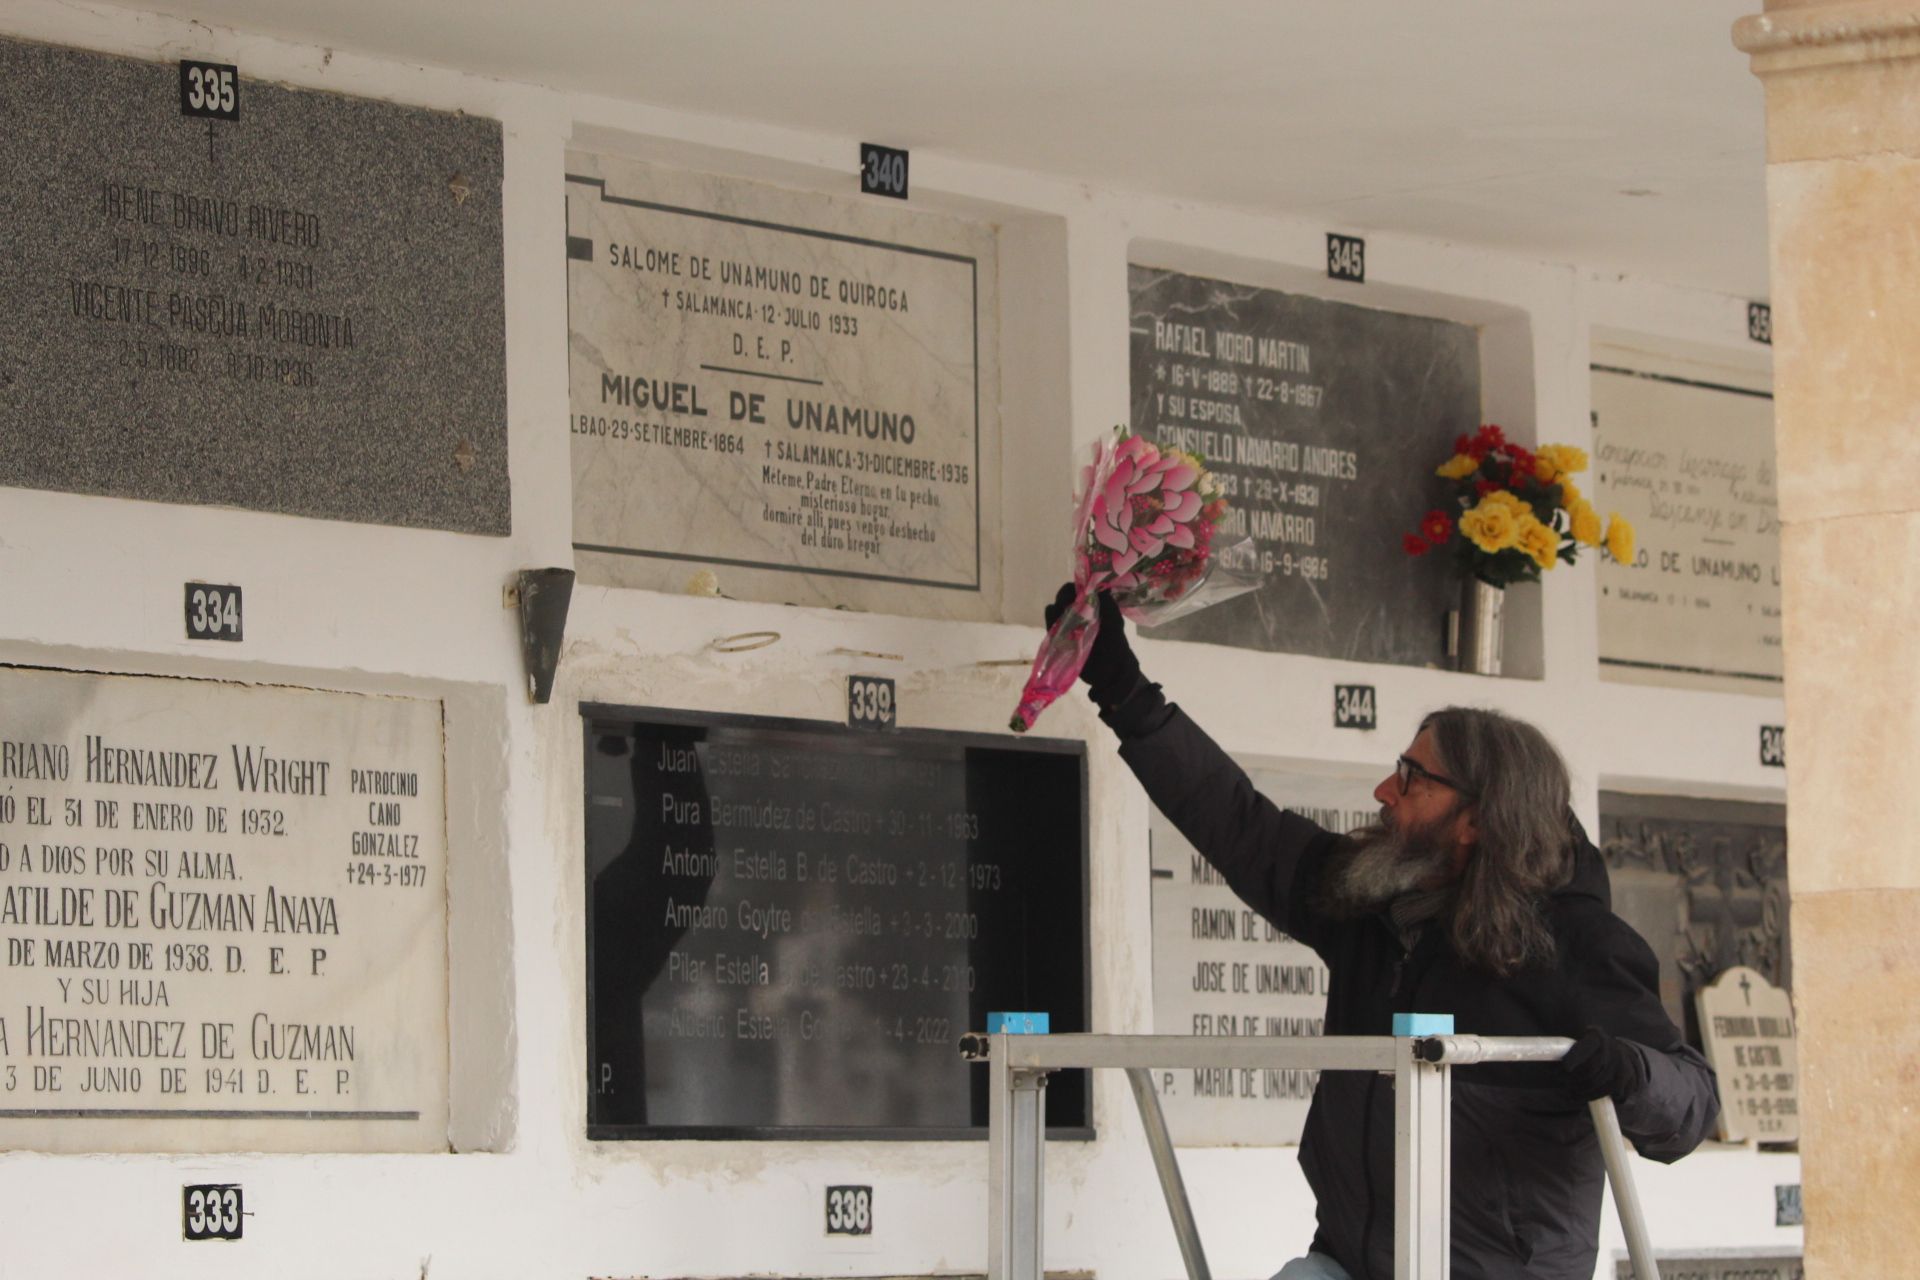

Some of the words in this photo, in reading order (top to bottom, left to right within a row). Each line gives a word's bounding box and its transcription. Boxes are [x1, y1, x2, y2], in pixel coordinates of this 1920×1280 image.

[188, 66, 235, 113] 335
[867, 151, 905, 193] 340
[101, 180, 162, 226] IRENE
[173, 192, 239, 237] BRAVO
[249, 204, 320, 249] RIVERO
[1329, 237, 1363, 278] 345
[609, 243, 681, 276] SALOME
[690, 255, 712, 281] DE
[720, 260, 801, 295] UNAMUNO
[810, 275, 831, 301] DE
[839, 280, 908, 313] QUIROGA
[69, 280, 158, 326] VICENTE
[169, 293, 248, 337] PASCUA
[259, 304, 353, 349] MORONTA
[829, 313, 858, 337] 1933
[1155, 321, 1211, 358] RAFAEL
[1258, 337, 1311, 374] MARTIN
[600, 373, 708, 416] MIGUEL
[729, 390, 766, 424] DE
[787, 398, 916, 445] UNAMUNO
[1157, 393, 1165, 415] Y
[1169, 395, 1185, 418] SU
[1189, 398, 1243, 426] ESPOSA
[1236, 434, 1299, 473] NAVARRO
[1303, 445, 1358, 480] ANDRES
[800, 490, 857, 515] misterioso
[801, 526, 817, 548] del
[828, 516, 852, 536] pues
[1251, 510, 1316, 546] NAVARRO
[1660, 550, 1681, 574] DE
[1691, 554, 1762, 584] UNAMUNO
[192, 590, 239, 634] 334
[852, 680, 892, 723] 339
[1337, 687, 1373, 725] 344
[1, 740, 70, 782] RIANO
[85, 734, 219, 790] HERNANDEZ
[231, 743, 330, 797] WRIGHT
[657, 741, 698, 773] Juan
[350, 769, 419, 798] PATROCINIO
[26, 795, 53, 826] EL
[64, 798, 83, 828] 31
[94, 799, 119, 829] DE
[132, 801, 194, 832] ENERO
[206, 806, 228, 834] DE
[368, 801, 402, 827] CANO
[662, 792, 701, 825] Pura
[710, 797, 792, 830] Bermúdez
[796, 801, 816, 831] de
[820, 801, 871, 836] Castro
[19, 843, 33, 873] A
[41, 844, 86, 875] DIOS
[95, 847, 134, 877] POR
[145, 849, 168, 878] SU
[177, 850, 243, 881] ALMA.
[351, 831, 419, 859] GONZALEZ
[662, 844, 722, 877] Antonio
[734, 848, 787, 881] Estella
[817, 853, 838, 883] de
[847, 853, 898, 886] Castro
[0, 885, 95, 927] ATILDE
[104, 889, 140, 929] DE
[150, 881, 256, 933] GUZMAN
[262, 885, 340, 936] ANAYA
[664, 896, 729, 936] Amparo
[738, 899, 792, 940] Goytre
[1191, 906, 1236, 940] RAMON
[1241, 909, 1259, 942] DE
[7, 937, 36, 967] DE
[44, 939, 120, 970] MARZO
[128, 942, 153, 970] DE
[668, 950, 707, 983] Pilar
[715, 953, 770, 985] Estella
[57, 977, 72, 1004] Y
[81, 978, 110, 1006] SU
[119, 979, 170, 1007] HIJA
[1192, 960, 1227, 993] JOSE
[1232, 962, 1250, 994] DE
[1256, 963, 1315, 996] UNAMUNO
[26, 1005, 187, 1059] HERNANDEZ
[200, 1022, 235, 1060] DE
[251, 1012, 355, 1062] GUZMAN
[5, 1065, 17, 1092] 3
[33, 1065, 62, 1092] DE
[80, 1066, 142, 1093] JUNIO
[160, 1067, 187, 1094] DE
[205, 1067, 243, 1095] 1941
[1193, 1067, 1234, 1098] MARIA
[1239, 1068, 1257, 1099] DE
[189, 1189, 239, 1234] 333
[829, 1189, 869, 1230] 338
